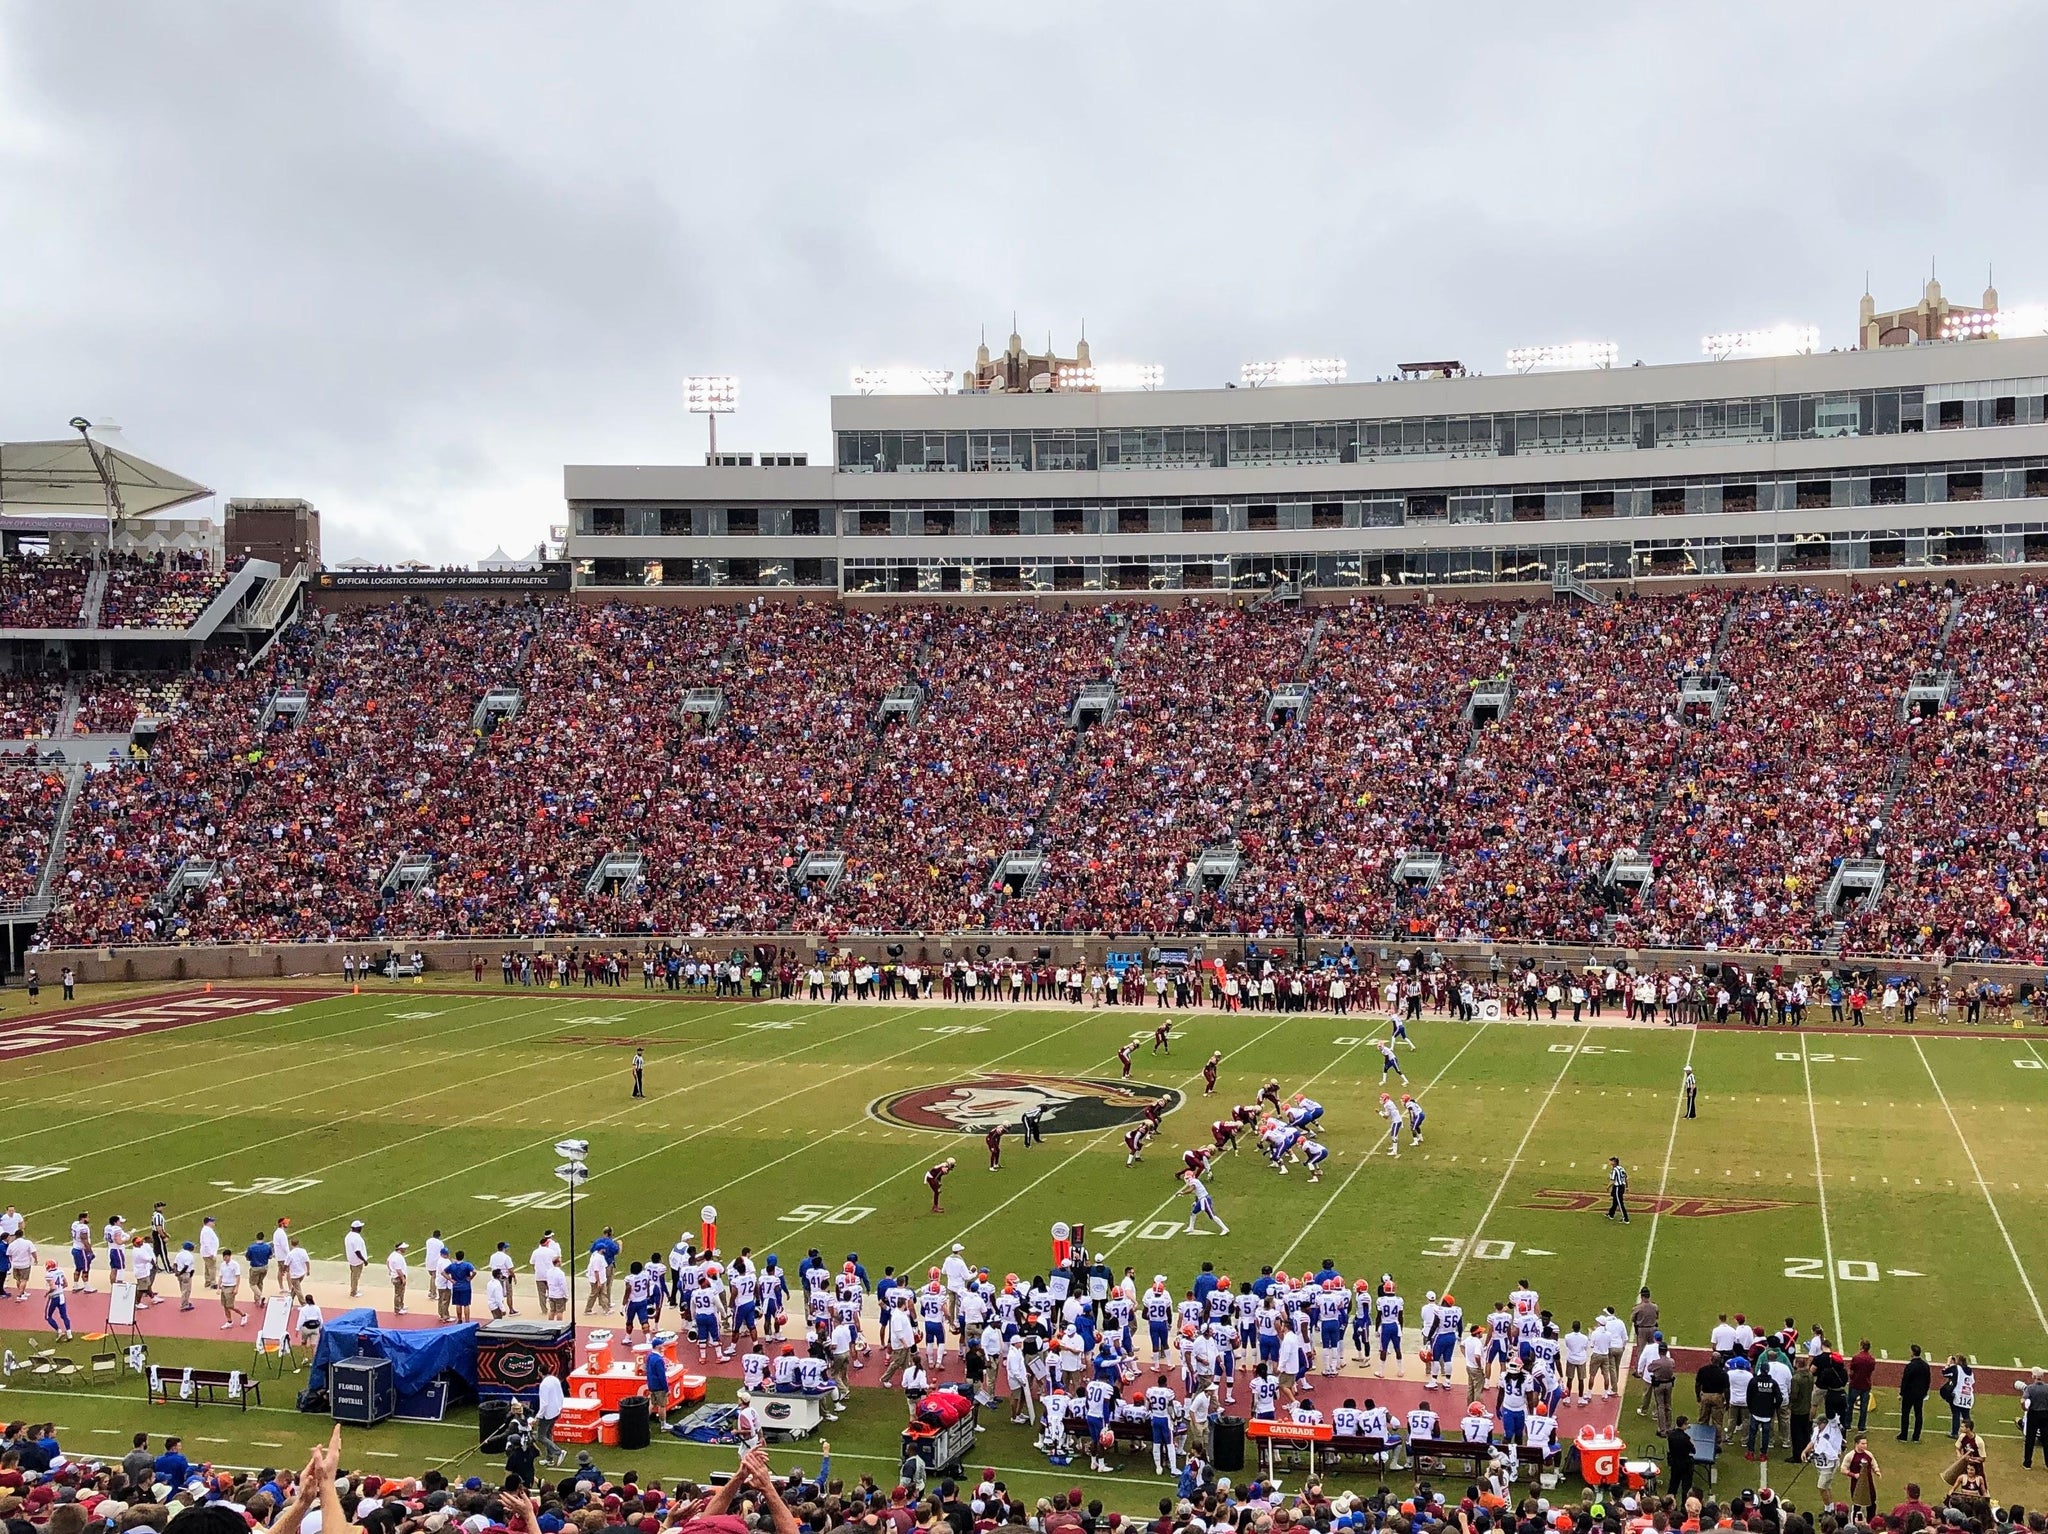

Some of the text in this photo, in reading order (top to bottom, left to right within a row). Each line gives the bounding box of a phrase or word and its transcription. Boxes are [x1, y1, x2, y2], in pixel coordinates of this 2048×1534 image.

[336, 577, 549, 585] OFFICIAL LOGISTICS COMPANY OF FLORIDA STATE ATHLETICS
[1775, 1052, 1836, 1062] 20
[777, 1204, 877, 1224] 50
[1091, 1220, 1185, 1240] 40
[1420, 1236, 1517, 1260] 30
[1783, 1257, 1880, 1282] 20
[634, 1279, 648, 1293] 53
[741, 1281, 754, 1296] 72
[695, 1296, 711, 1308] 59
[925, 1301, 939, 1315] 45
[1036, 1300, 1051, 1313] 52
[1211, 1298, 1227, 1312] 56
[1243, 1302, 1252, 1315] 5
[1323, 1302, 1337, 1315] 14
[1112, 1306, 1128, 1321] 34
[1150, 1305, 1166, 1318] 28
[1184, 1308, 1200, 1322] 43
[1383, 1304, 1399, 1318] 84
[1259, 1316, 1272, 1329] 70
[1443, 1315, 1459, 1329] 56
[1495, 1321, 1509, 1334] 46
[1522, 1321, 1537, 1337] 44
[1213, 1332, 1227, 1346] 42
[588, 1354, 597, 1363] G
[636, 1355, 644, 1364] G
[1535, 1345, 1551, 1361] 96
[744, 1359, 759, 1374] 33
[779, 1361, 789, 1375] 11
[800, 1365, 817, 1380] 44
[338, 1382, 364, 1392] FLORIDA
[579, 1382, 598, 1399] G
[673, 1382, 681, 1399] G
[1260, 1383, 1275, 1399] 99
[1506, 1383, 1523, 1396] 93
[338, 1396, 364, 1406] FOOTBALL
[1088, 1386, 1103, 1403] 30
[1959, 1396, 1972, 1406] 114
[1052, 1398, 1060, 1412] 5
[1150, 1396, 1167, 1411] 29
[1337, 1413, 1355, 1428] 92
[1363, 1416, 1382, 1434] 54
[1412, 1415, 1430, 1429] 55
[553, 1430, 583, 1438] GATORADE
[1269, 1425, 1315, 1437] GATORADE
[1471, 1424, 1480, 1440] 7
[1529, 1421, 1545, 1436] 17
[1594, 1455, 1613, 1476] G
